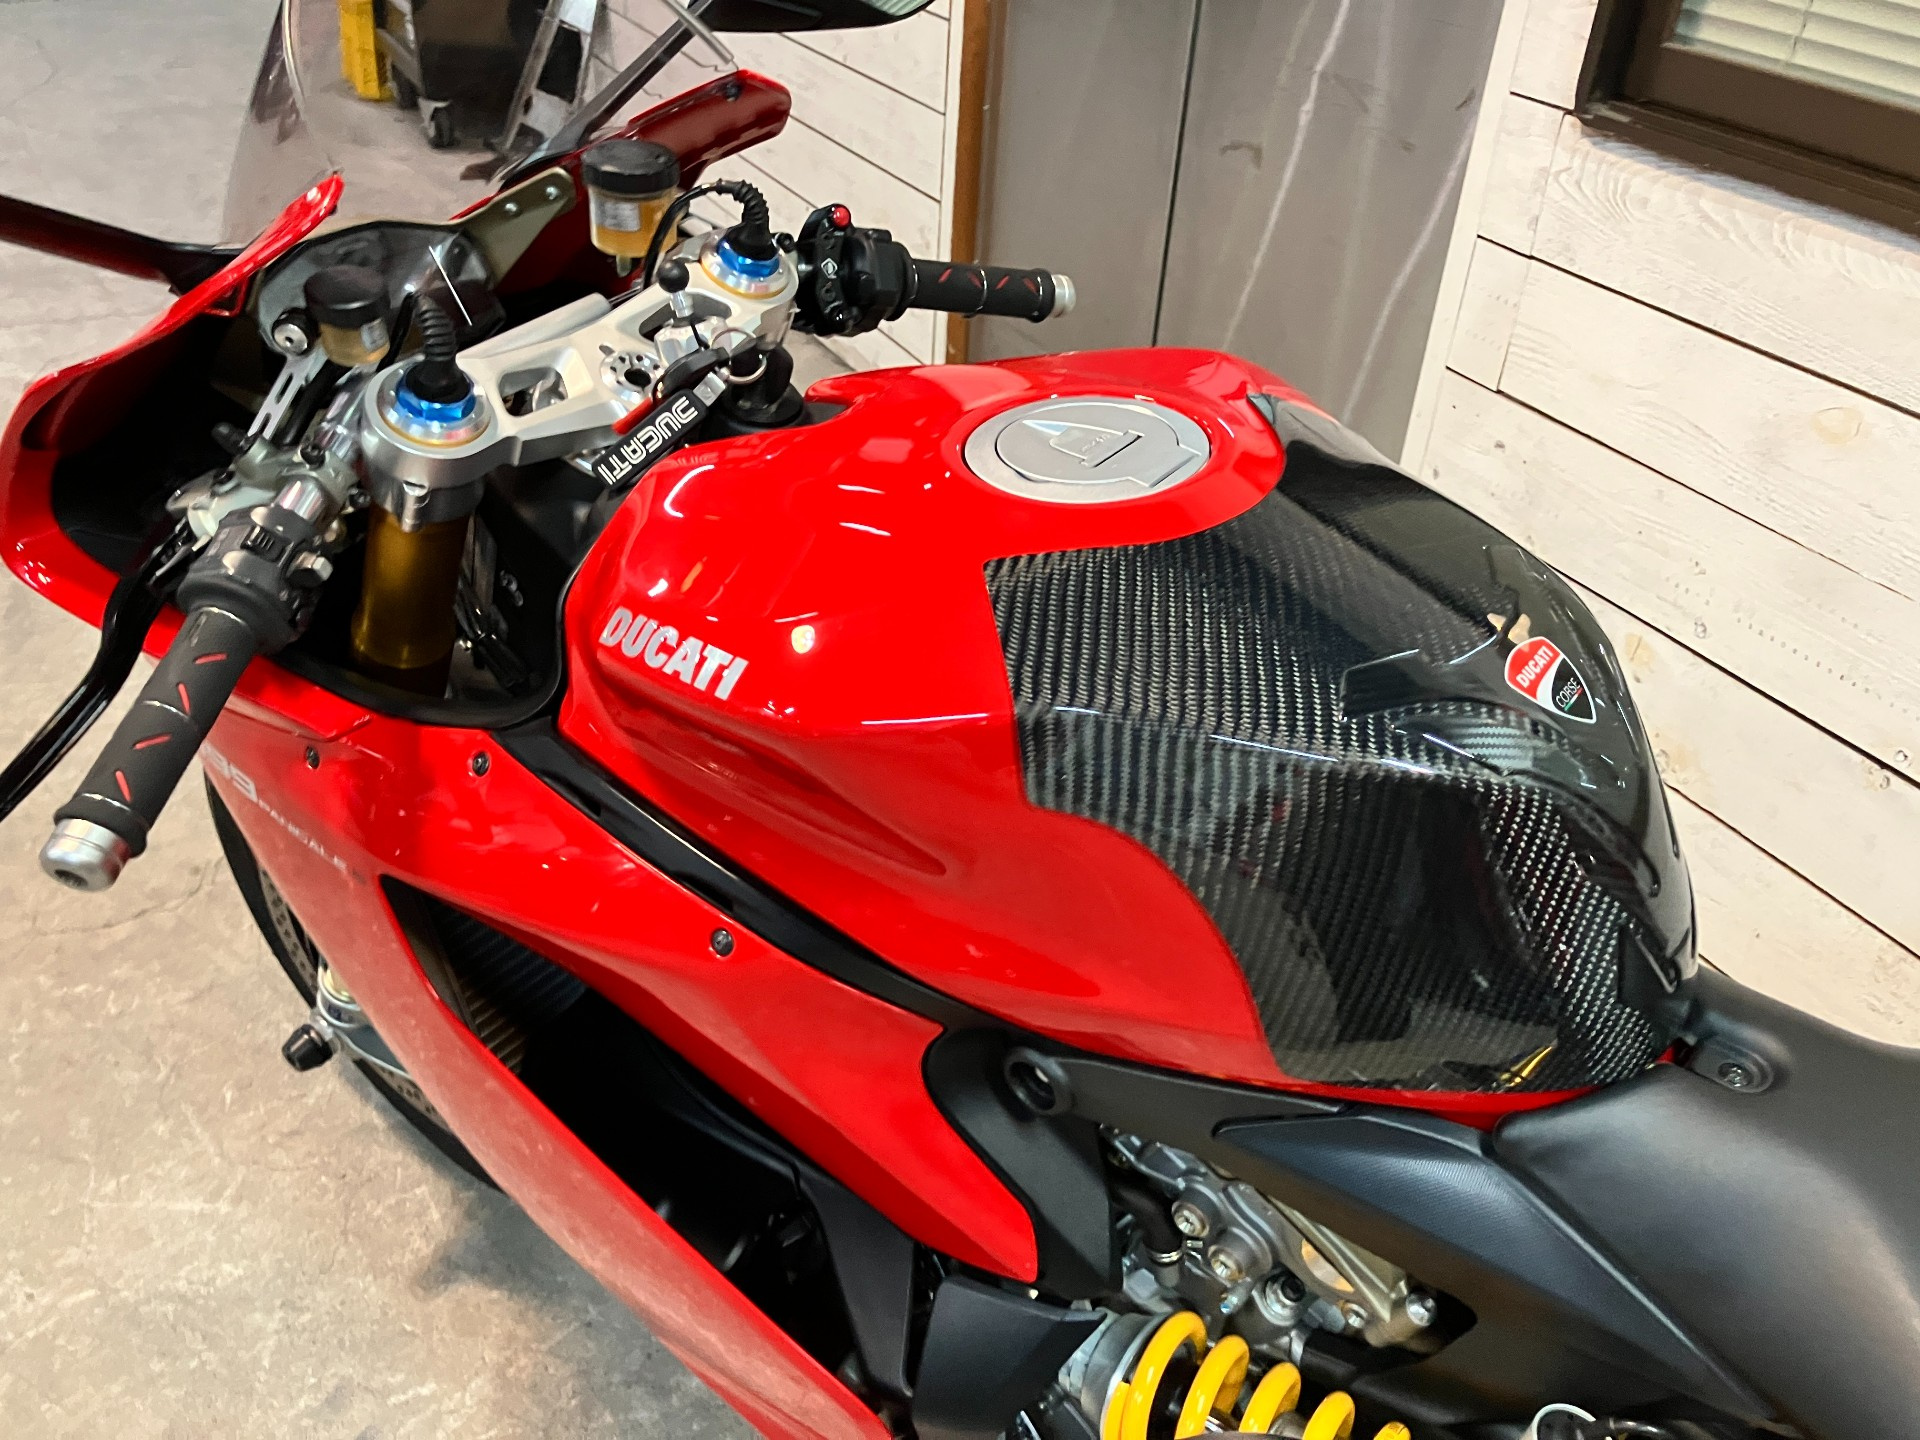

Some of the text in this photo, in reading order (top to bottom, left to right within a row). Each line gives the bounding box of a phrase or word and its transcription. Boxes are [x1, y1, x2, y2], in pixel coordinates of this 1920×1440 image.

[598, 396, 698, 485] DUCATI
[598, 606, 749, 701] DUCATI
[1516, 645, 1554, 688] DUCATI
[1556, 677, 1581, 708] CORSE
